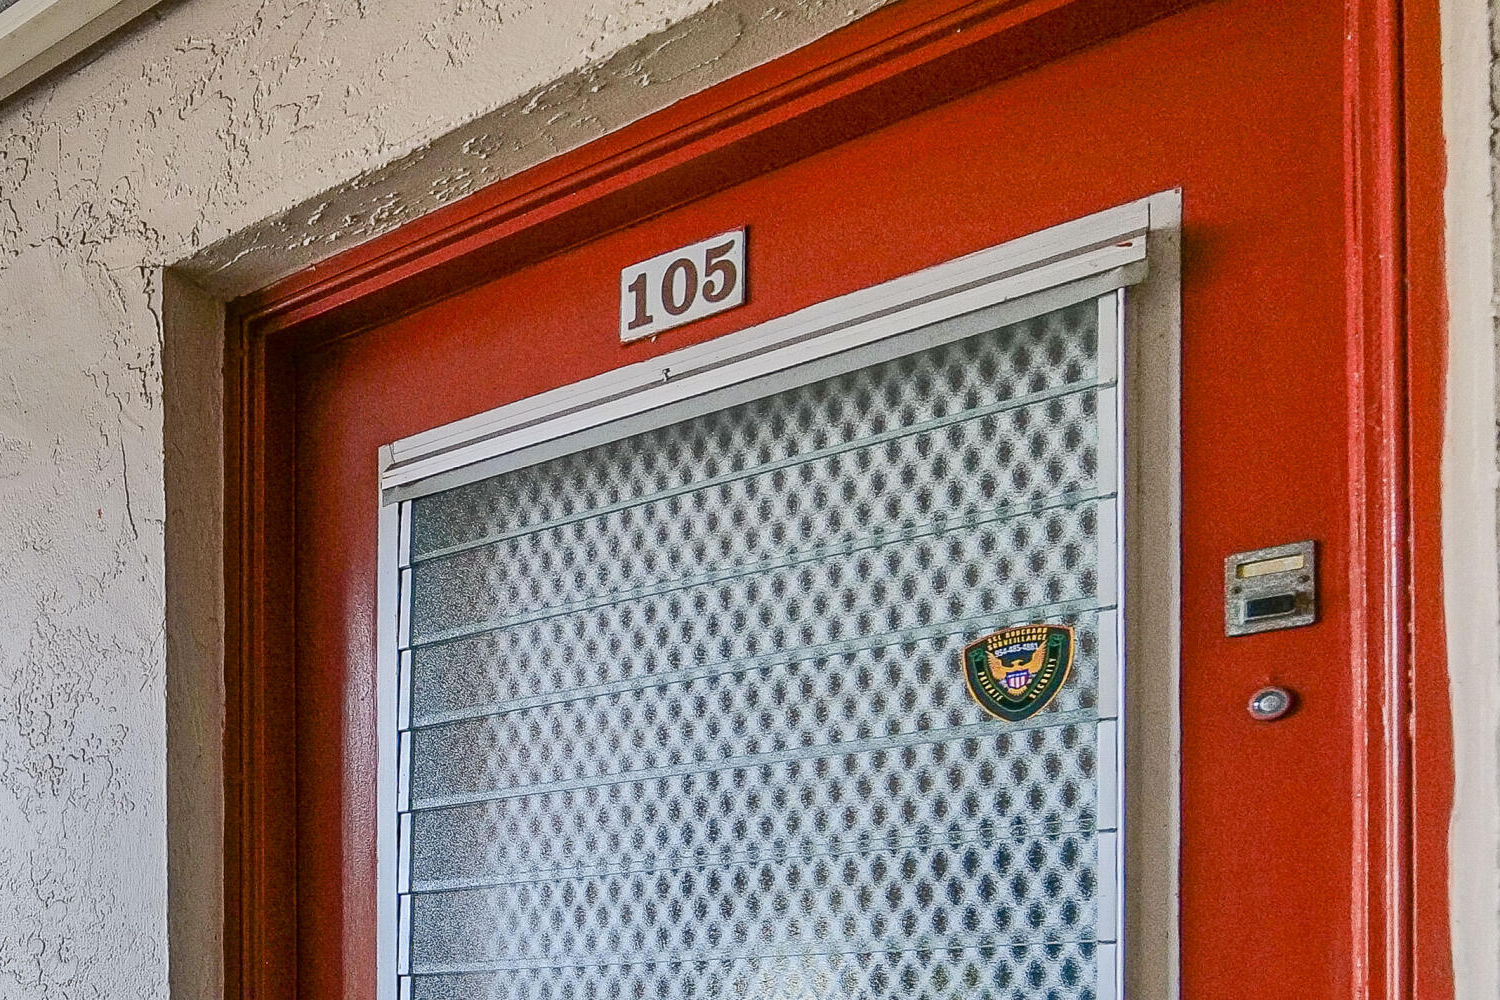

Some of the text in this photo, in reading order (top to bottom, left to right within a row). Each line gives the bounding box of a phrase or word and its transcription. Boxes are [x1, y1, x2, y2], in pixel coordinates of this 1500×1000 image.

[628, 239, 737, 330] 105
[977, 671, 1004, 701] PRIVATE
[1029, 657, 1057, 699] SECURITY
